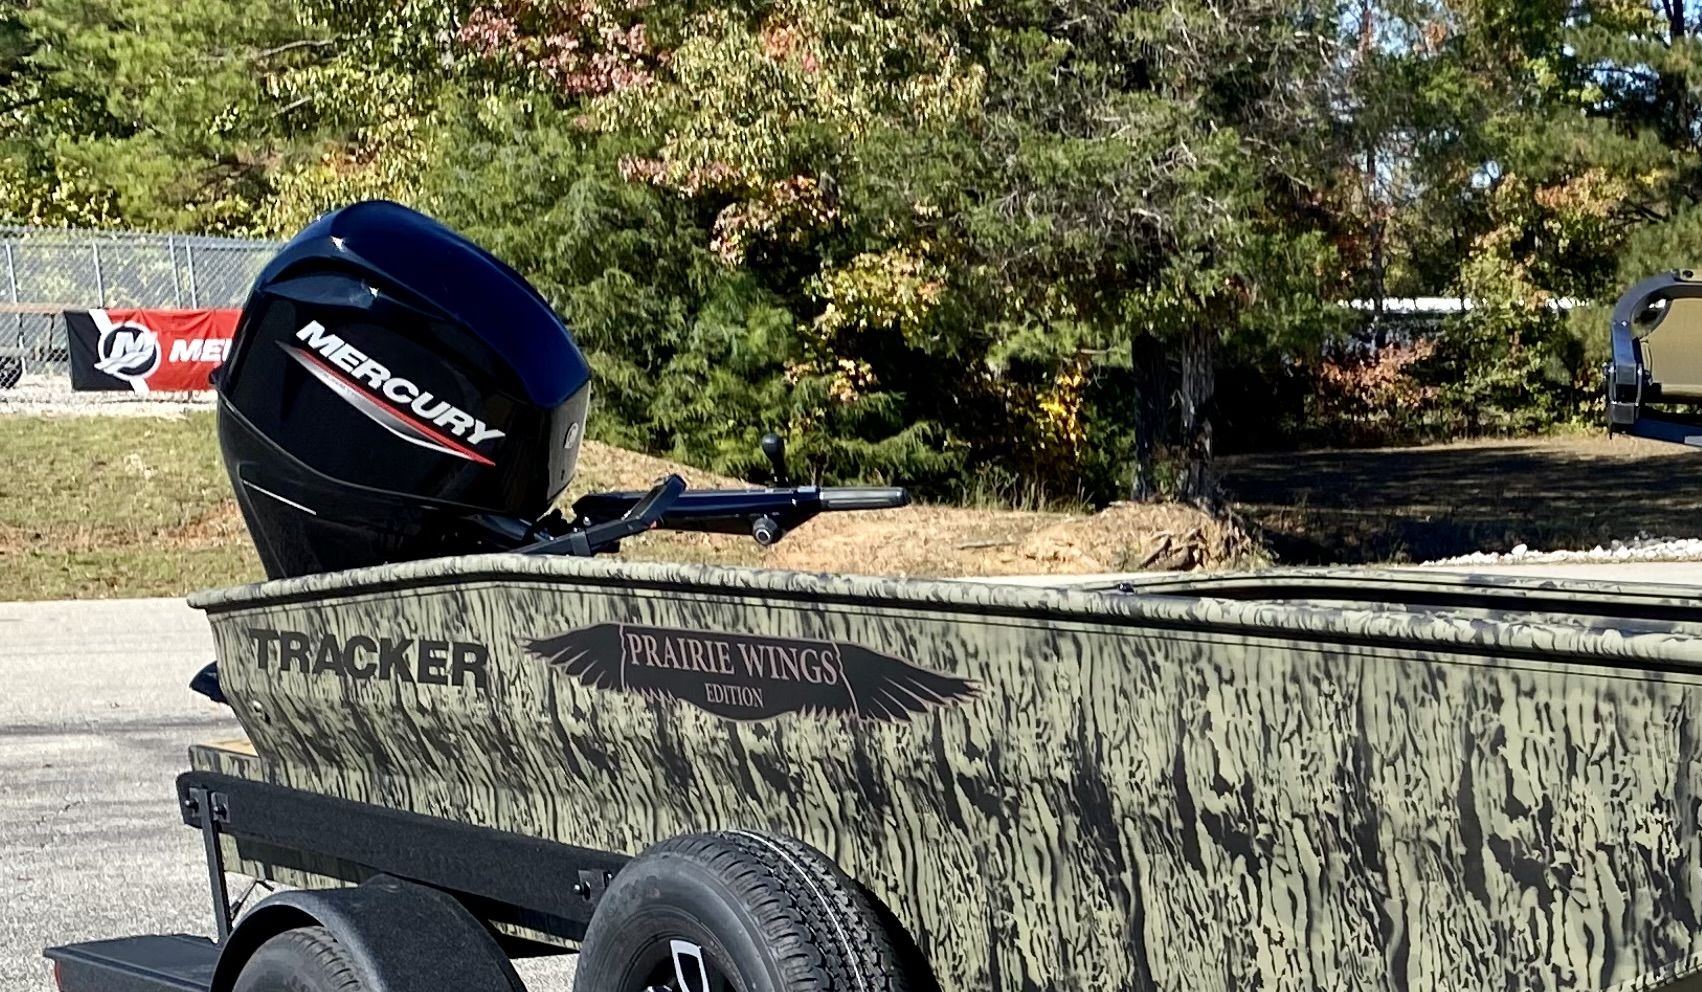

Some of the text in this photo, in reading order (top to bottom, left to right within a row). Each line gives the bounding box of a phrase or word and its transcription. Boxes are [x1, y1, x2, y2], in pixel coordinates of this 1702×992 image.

[296, 320, 506, 445] MERCURY
[249, 628, 487, 687] TRACKER
[626, 633, 837, 685] PRAIRIE WINGS
[704, 683, 764, 708] EDITION
